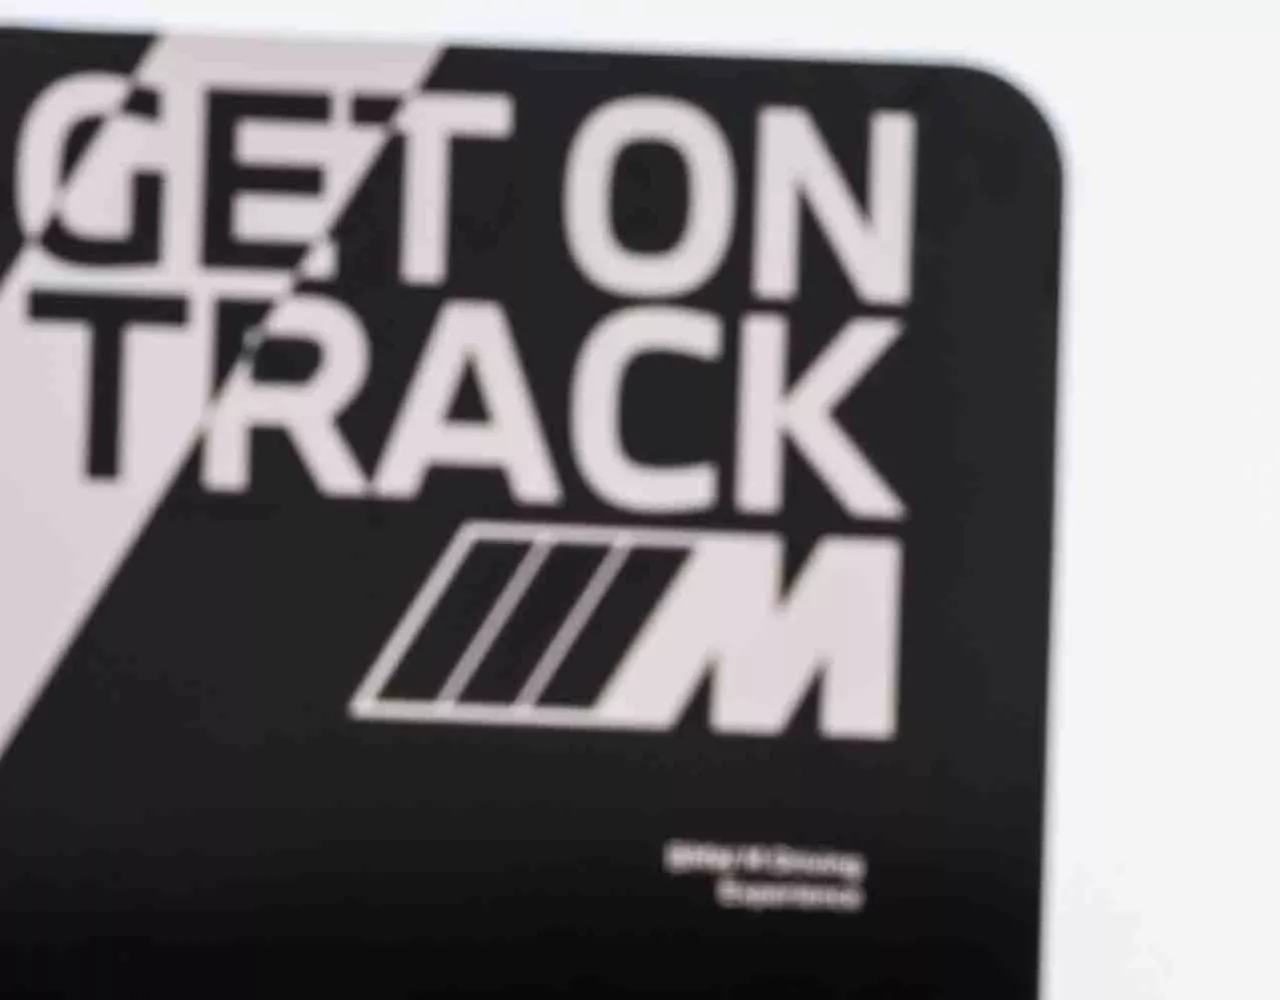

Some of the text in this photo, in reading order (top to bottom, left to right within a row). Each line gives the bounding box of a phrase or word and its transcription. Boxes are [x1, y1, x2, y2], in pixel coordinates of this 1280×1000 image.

[15, 72, 918, 305] GET ON
[25, 287, 908, 521] TRACK
[592, 530, 904, 741] M
